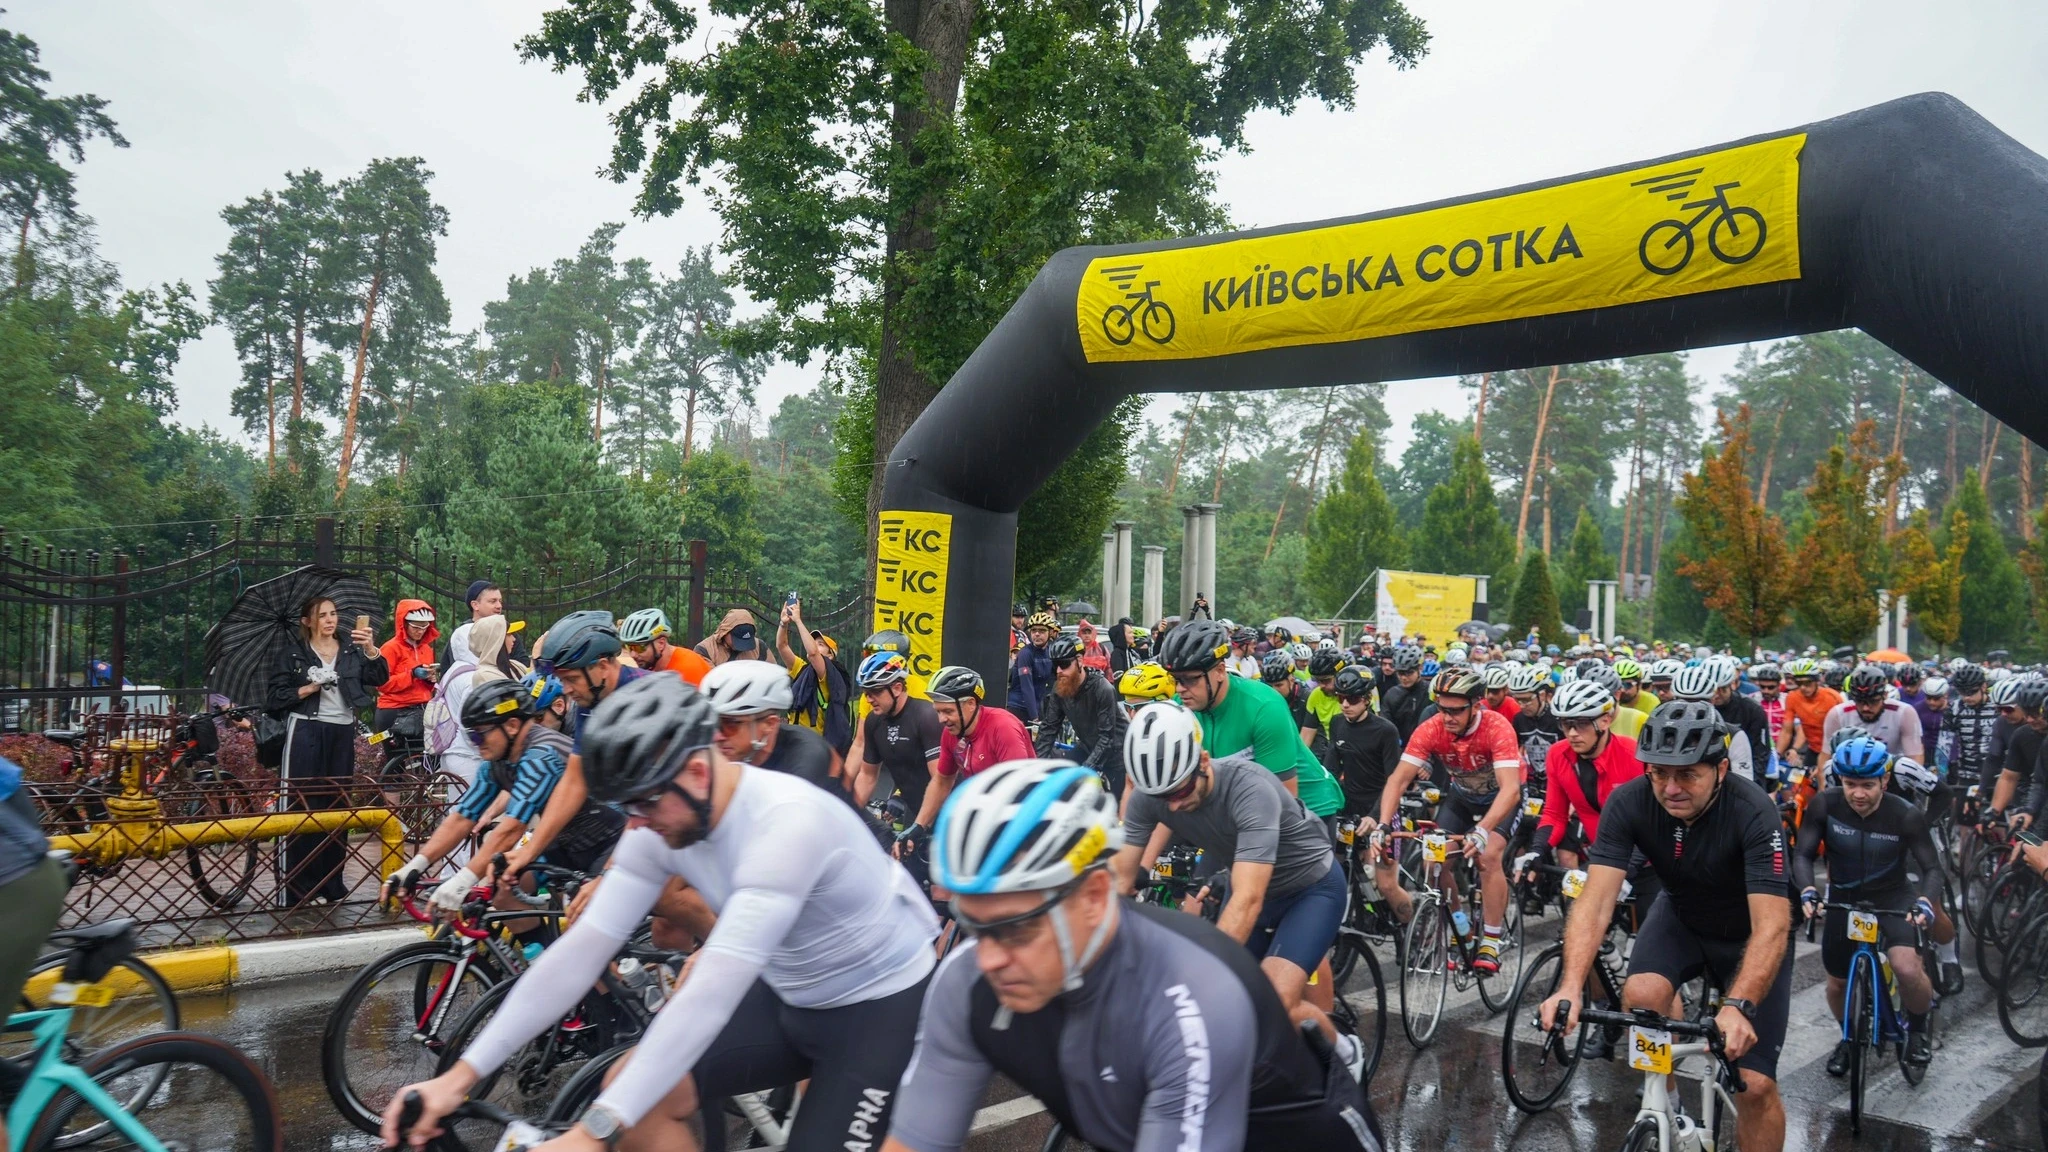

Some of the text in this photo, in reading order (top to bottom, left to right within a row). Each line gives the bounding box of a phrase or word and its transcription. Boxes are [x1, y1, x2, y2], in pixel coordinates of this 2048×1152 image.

[1202, 222, 1583, 315] КИЇВСЬКА СОТКА
[904, 528, 942, 553] КС
[901, 570, 939, 594] КС
[899, 610, 935, 635] КС
[1853, 919, 1874, 931] 910
[1635, 1039, 1666, 1057] 841
